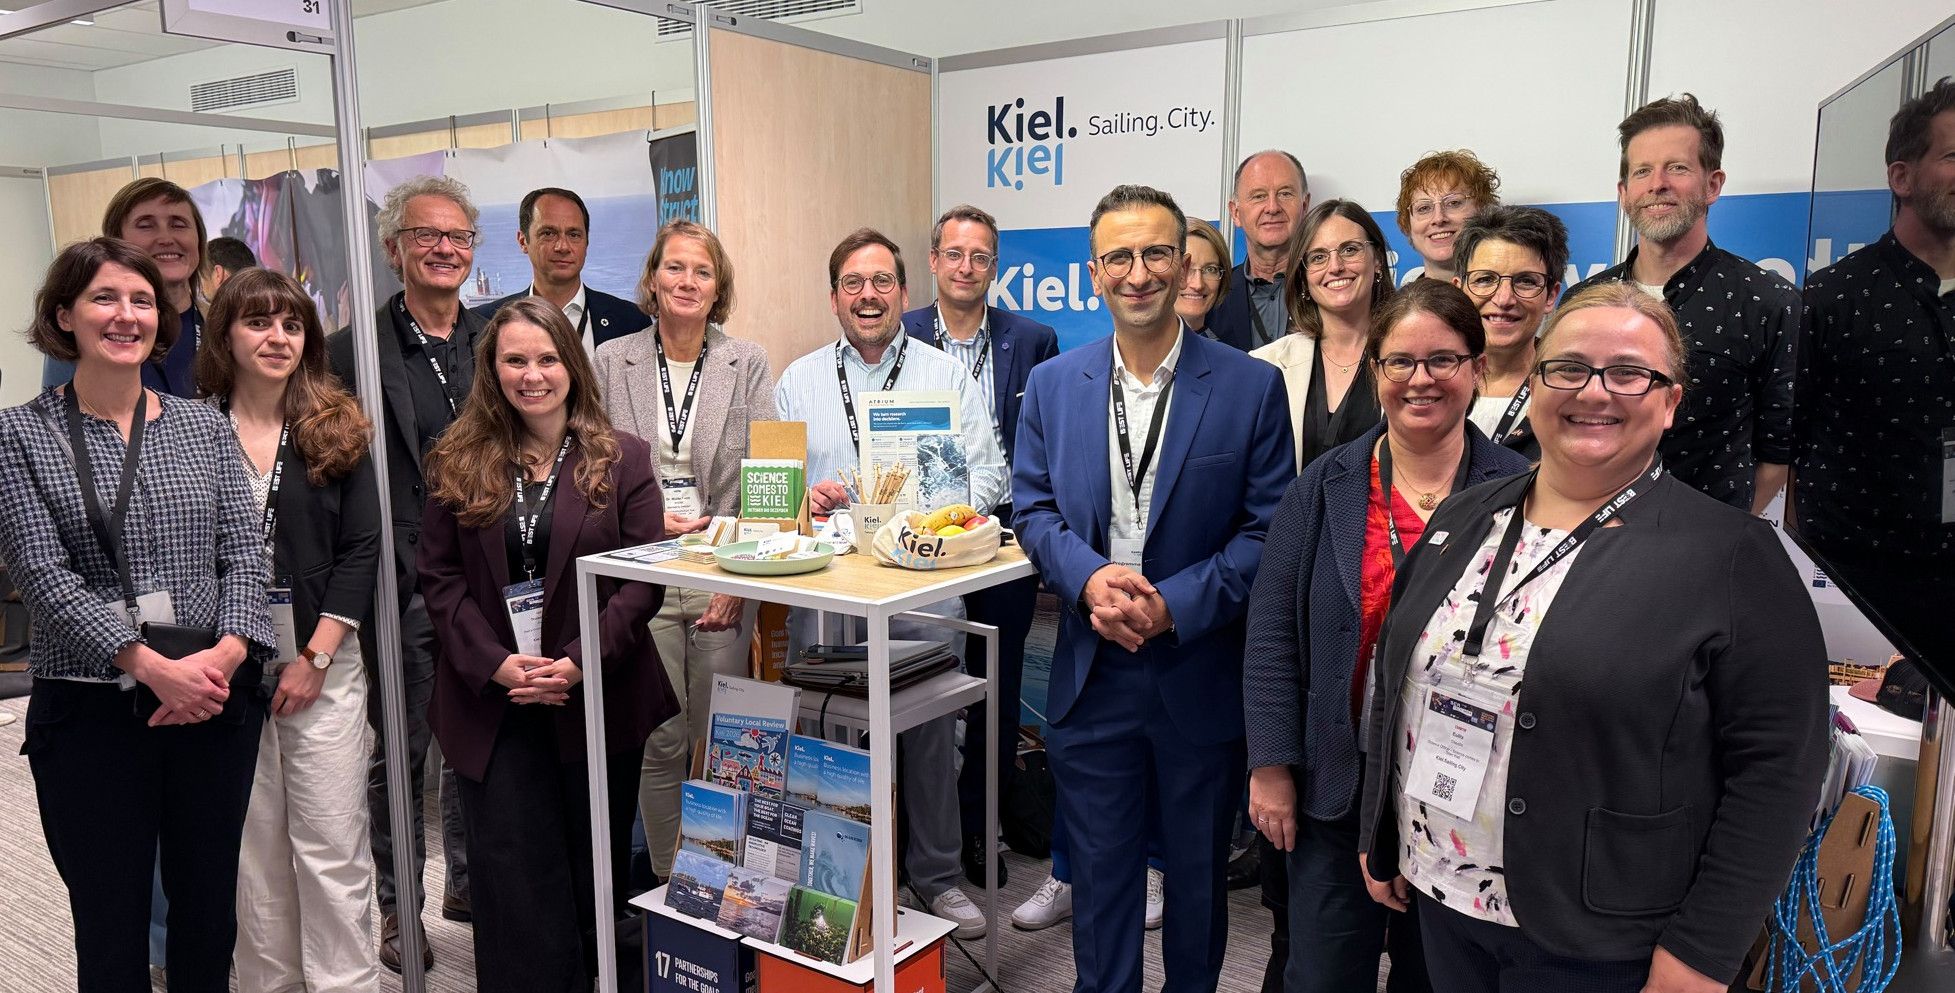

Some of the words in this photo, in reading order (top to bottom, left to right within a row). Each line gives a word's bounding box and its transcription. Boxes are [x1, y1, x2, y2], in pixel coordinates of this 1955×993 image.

[303, 0, 320, 14] 31
[987, 96, 1078, 145] Kiel.
[1088, 112, 1164, 137] Sailing.
[1167, 107, 1216, 132] City.
[987, 262, 1100, 311] Kiel.
[1507, 400, 1520, 417] BEST
[1117, 416, 1126, 435] BEST
[1494, 432, 1503, 445] IFE
[272, 473, 281, 491] BEST
[747, 472, 789, 484] SCIENCE
[747, 485, 776, 495] COMES
[777, 485, 789, 495] TO
[1615, 488, 1637, 509] BEST
[762, 495, 789, 506] KIEL
[1595, 507, 1616, 523] LIFE
[898, 525, 946, 558] Kiel.
[1554, 536, 1578, 558] BEST
[716, 715, 744, 726] Voluntary
[745, 718, 761, 727] Local
[762, 720, 785, 729] Review
[655, 950, 671, 979] 17
[674, 957, 719, 984] PARTNERSHIPS
[675, 973, 687, 986] FOR
[688, 977, 700, 992] THE
